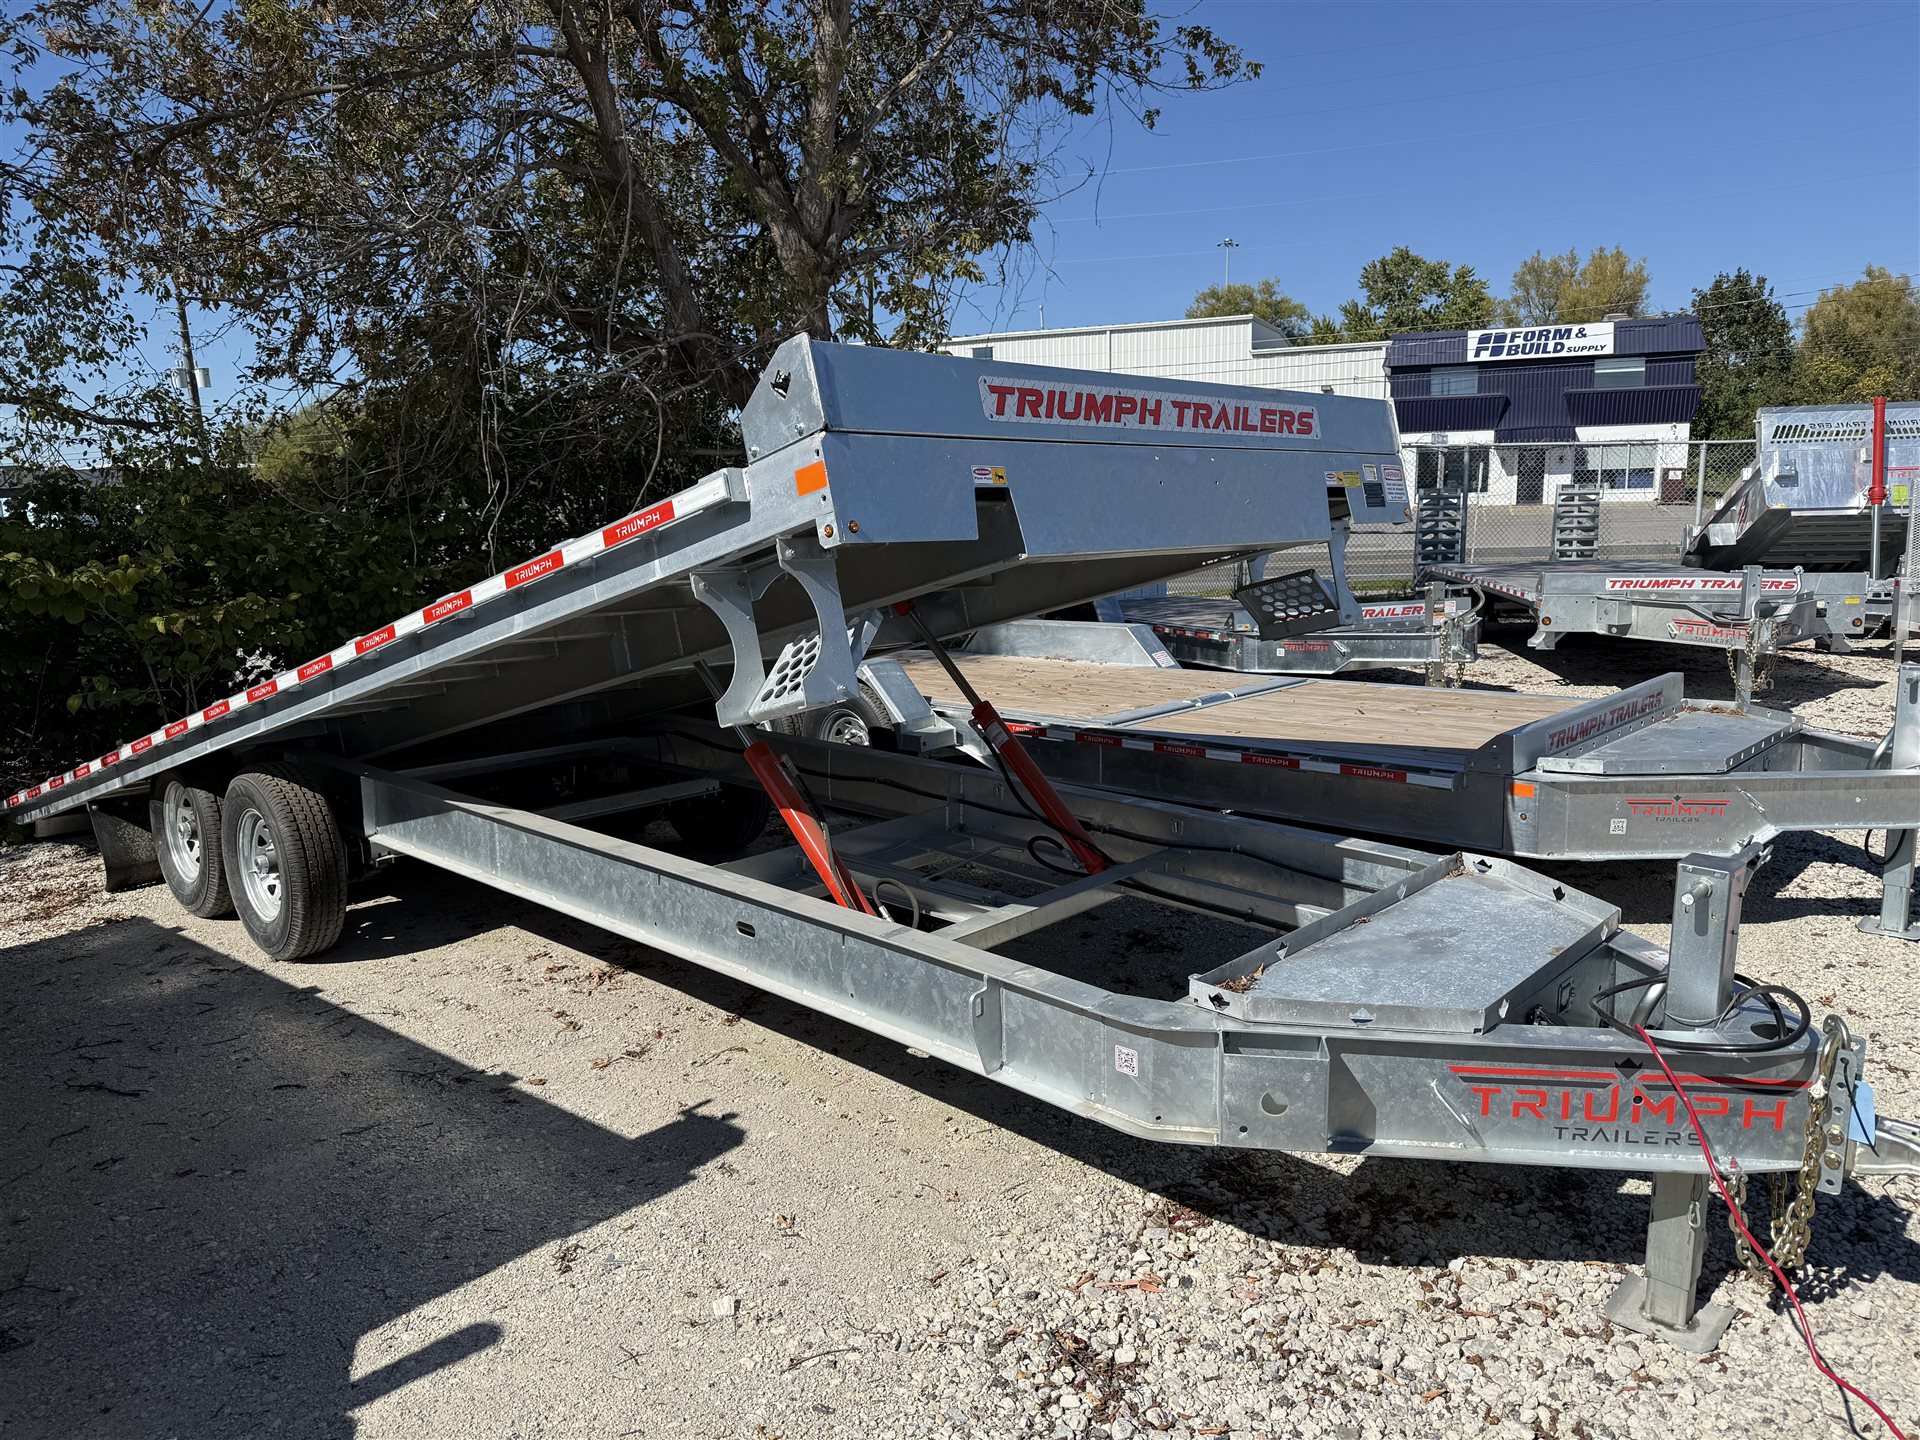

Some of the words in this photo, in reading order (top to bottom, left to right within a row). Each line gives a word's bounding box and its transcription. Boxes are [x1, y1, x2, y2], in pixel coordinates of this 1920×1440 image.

[1509, 328, 1573, 343] FORM
[1575, 327, 1588, 339] &
[1506, 342, 1566, 356] BUILD
[1566, 344, 1607, 353] SUPPLY
[987, 384, 1162, 425] TRIUMPH
[1170, 400, 1315, 434] TRAILERS
[615, 511, 660, 538] TRIUMPH
[515, 559, 552, 581] TRIUMPH
[1609, 579, 1695, 589] TRIUMPH
[1700, 579, 1797, 590] TRAIERS
[431, 598, 463, 618] TRIUMPH
[1361, 605, 1425, 618] RAILER
[362, 631, 389, 649] TRIUMPH
[1675, 624, 1748, 640] TRIUMPH
[1284, 644, 1329, 652] TRIUMPH
[303, 660, 327, 676] TRIUMPH
[1548, 713, 1607, 752] TRIUMPH
[1609, 690, 1663, 726] TRAILERS
[1083, 735, 1114, 745] TRIUMPH
[1162, 745, 1197, 755] TRIUMPH
[1252, 756, 1289, 766] TRIUMPH
[1352, 767, 1394, 779] TRIUMPH
[1630, 804, 1725, 817] TRIUMPH
[1470, 1084, 1789, 1131] TRIUMPH
[1553, 1126, 1703, 1147] TRAILERS
